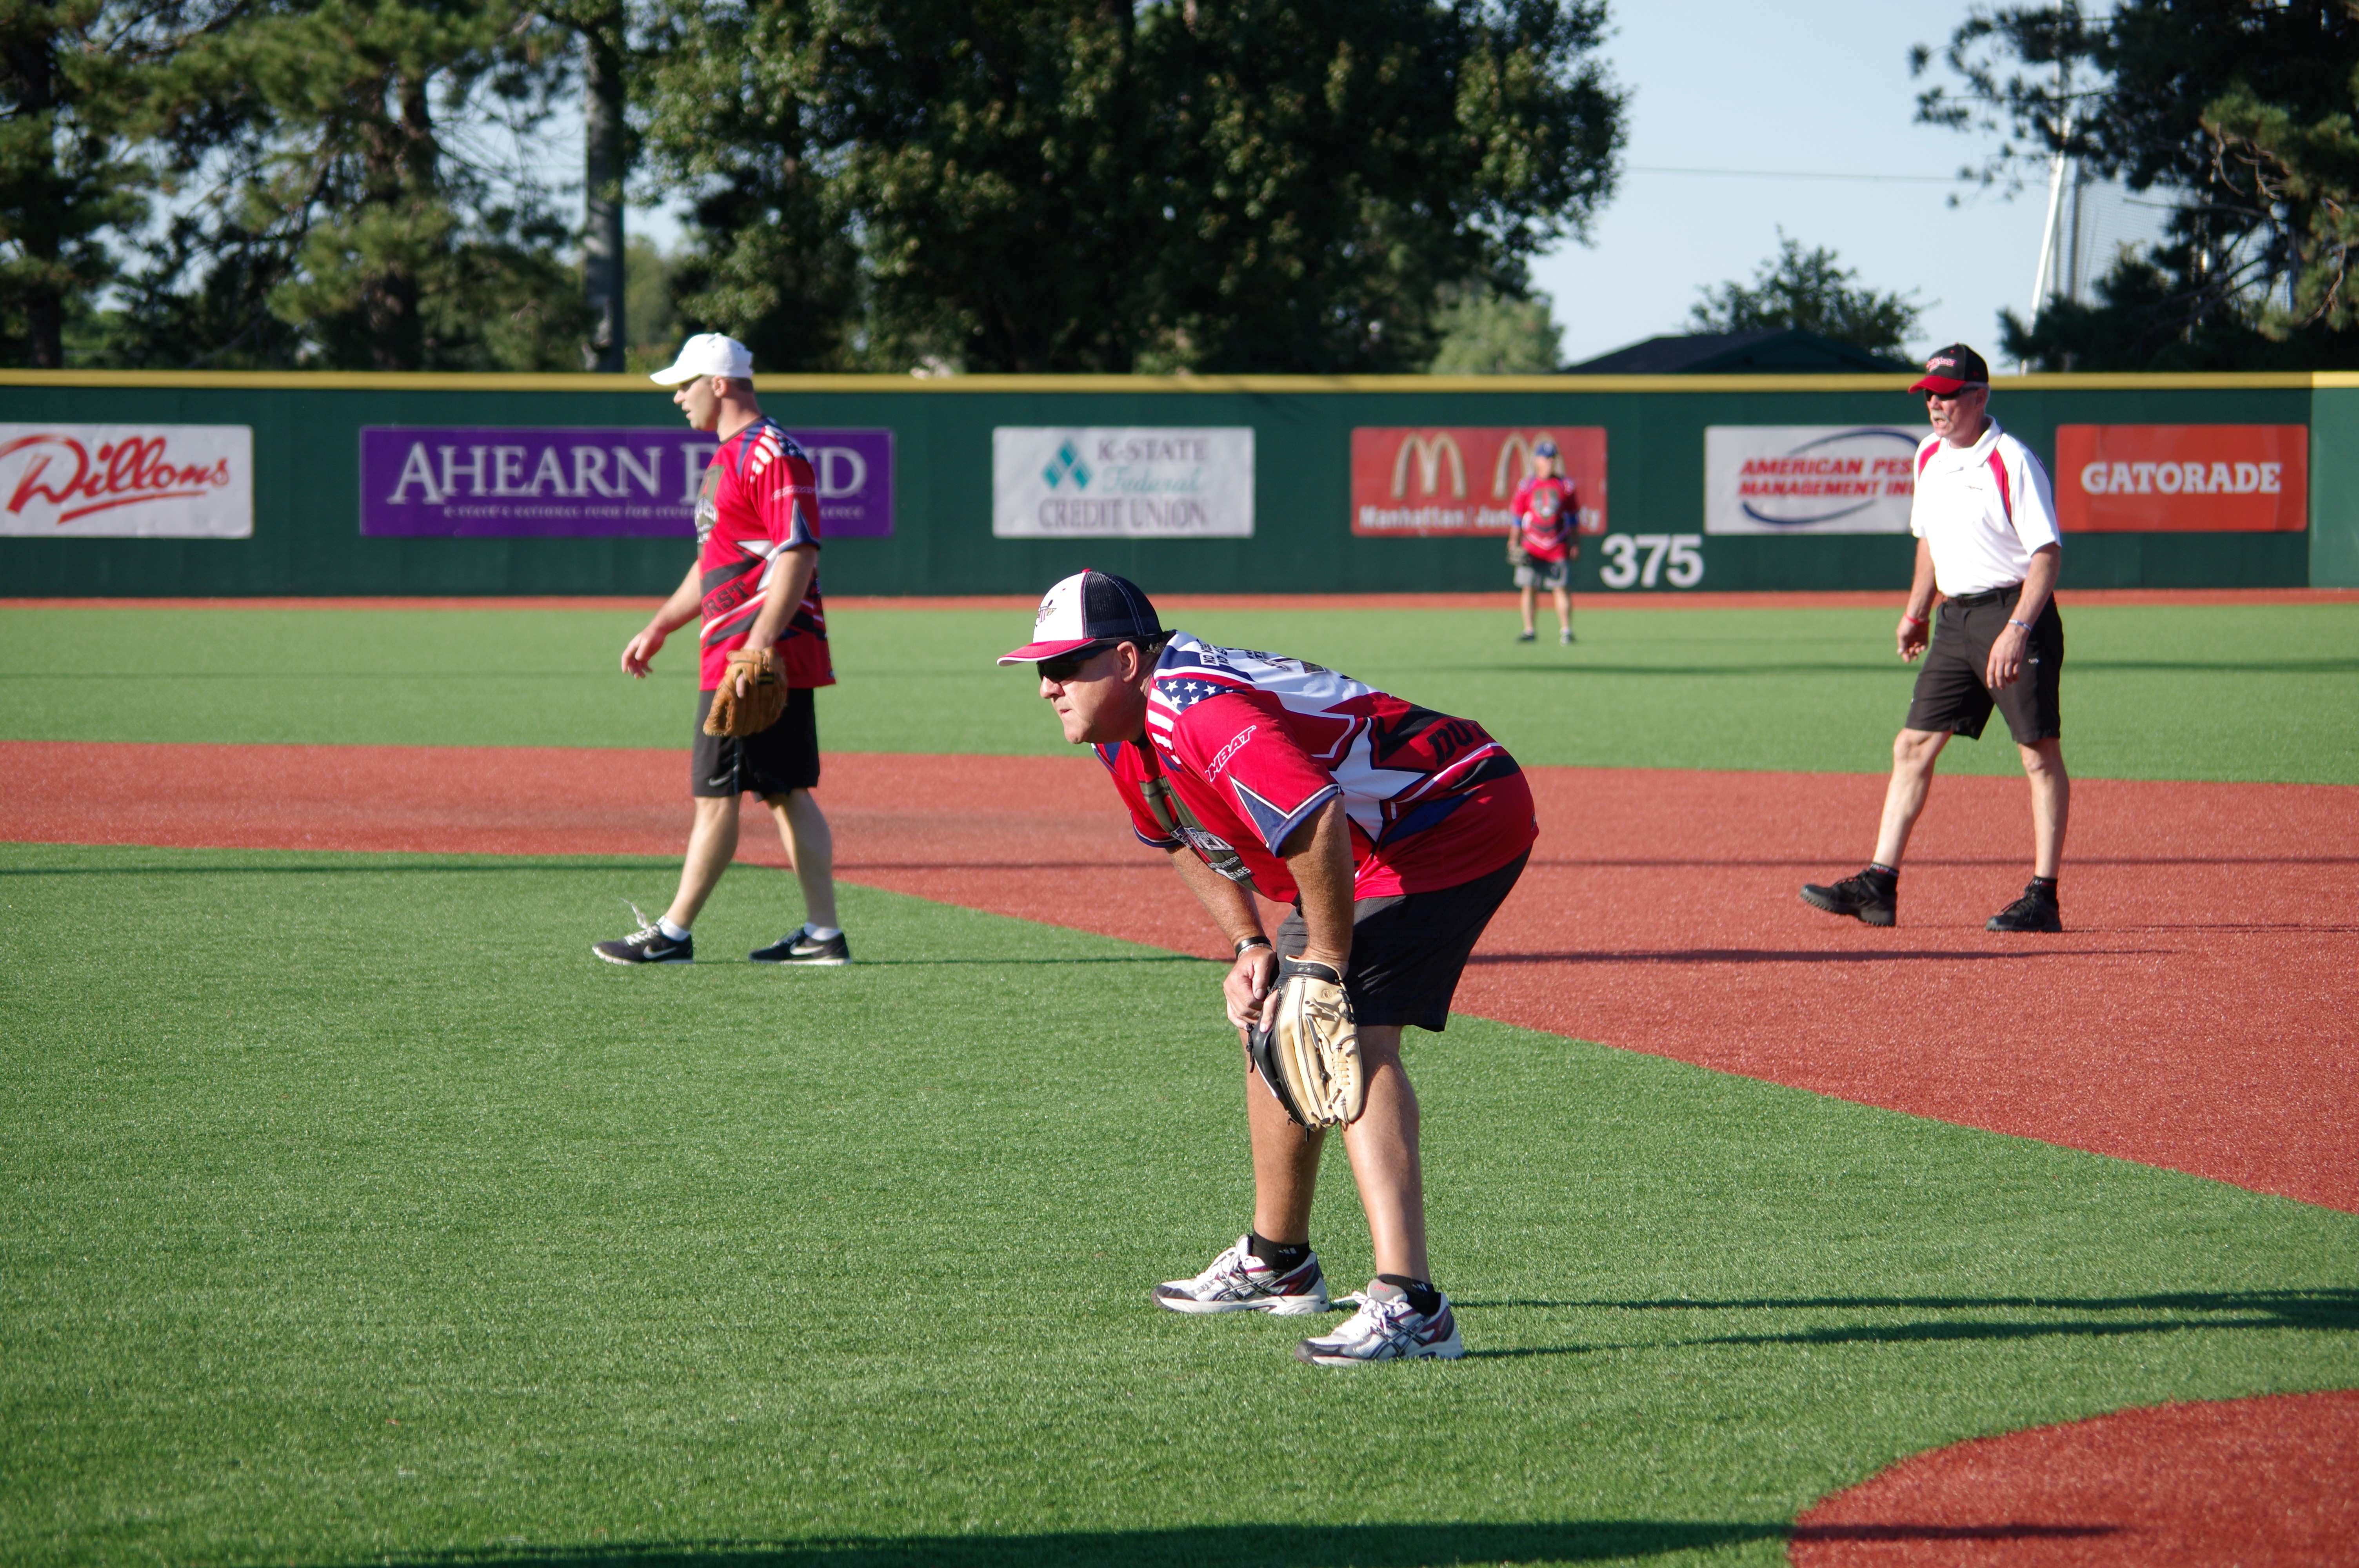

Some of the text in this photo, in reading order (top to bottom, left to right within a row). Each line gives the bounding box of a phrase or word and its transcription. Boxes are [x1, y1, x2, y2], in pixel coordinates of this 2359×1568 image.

[1098, 438, 1207, 462] K-STATE
[0, 434, 229, 514] Dillons
[386, 441, 867, 506] AHEARN FD
[1101, 466, 1202, 493] Federal
[1739, 457, 1914, 476] AMERICAN PES
[2081, 461, 2281, 495] GATORADE
[1737, 479, 1881, 497] MANAGEMENT
[1038, 497, 1208, 528] CREDIT UNION
[1600, 534, 1704, 588] 375
[1205, 725, 1256, 782] MBAT
